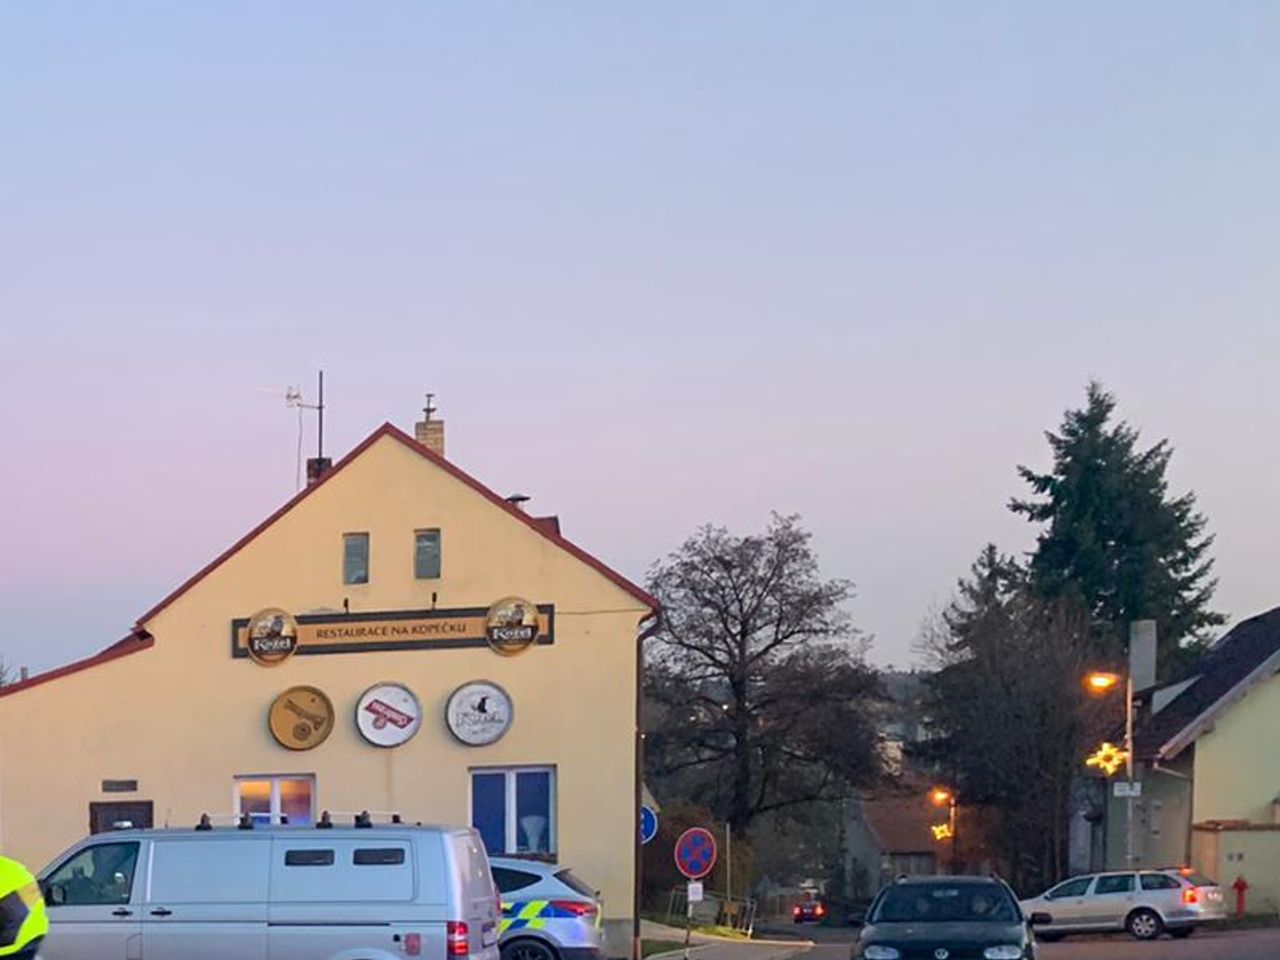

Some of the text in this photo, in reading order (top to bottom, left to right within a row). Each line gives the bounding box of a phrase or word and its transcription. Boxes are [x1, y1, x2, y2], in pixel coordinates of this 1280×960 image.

[316, 622, 467, 639] RESTAURACE NA KOPEČKU
